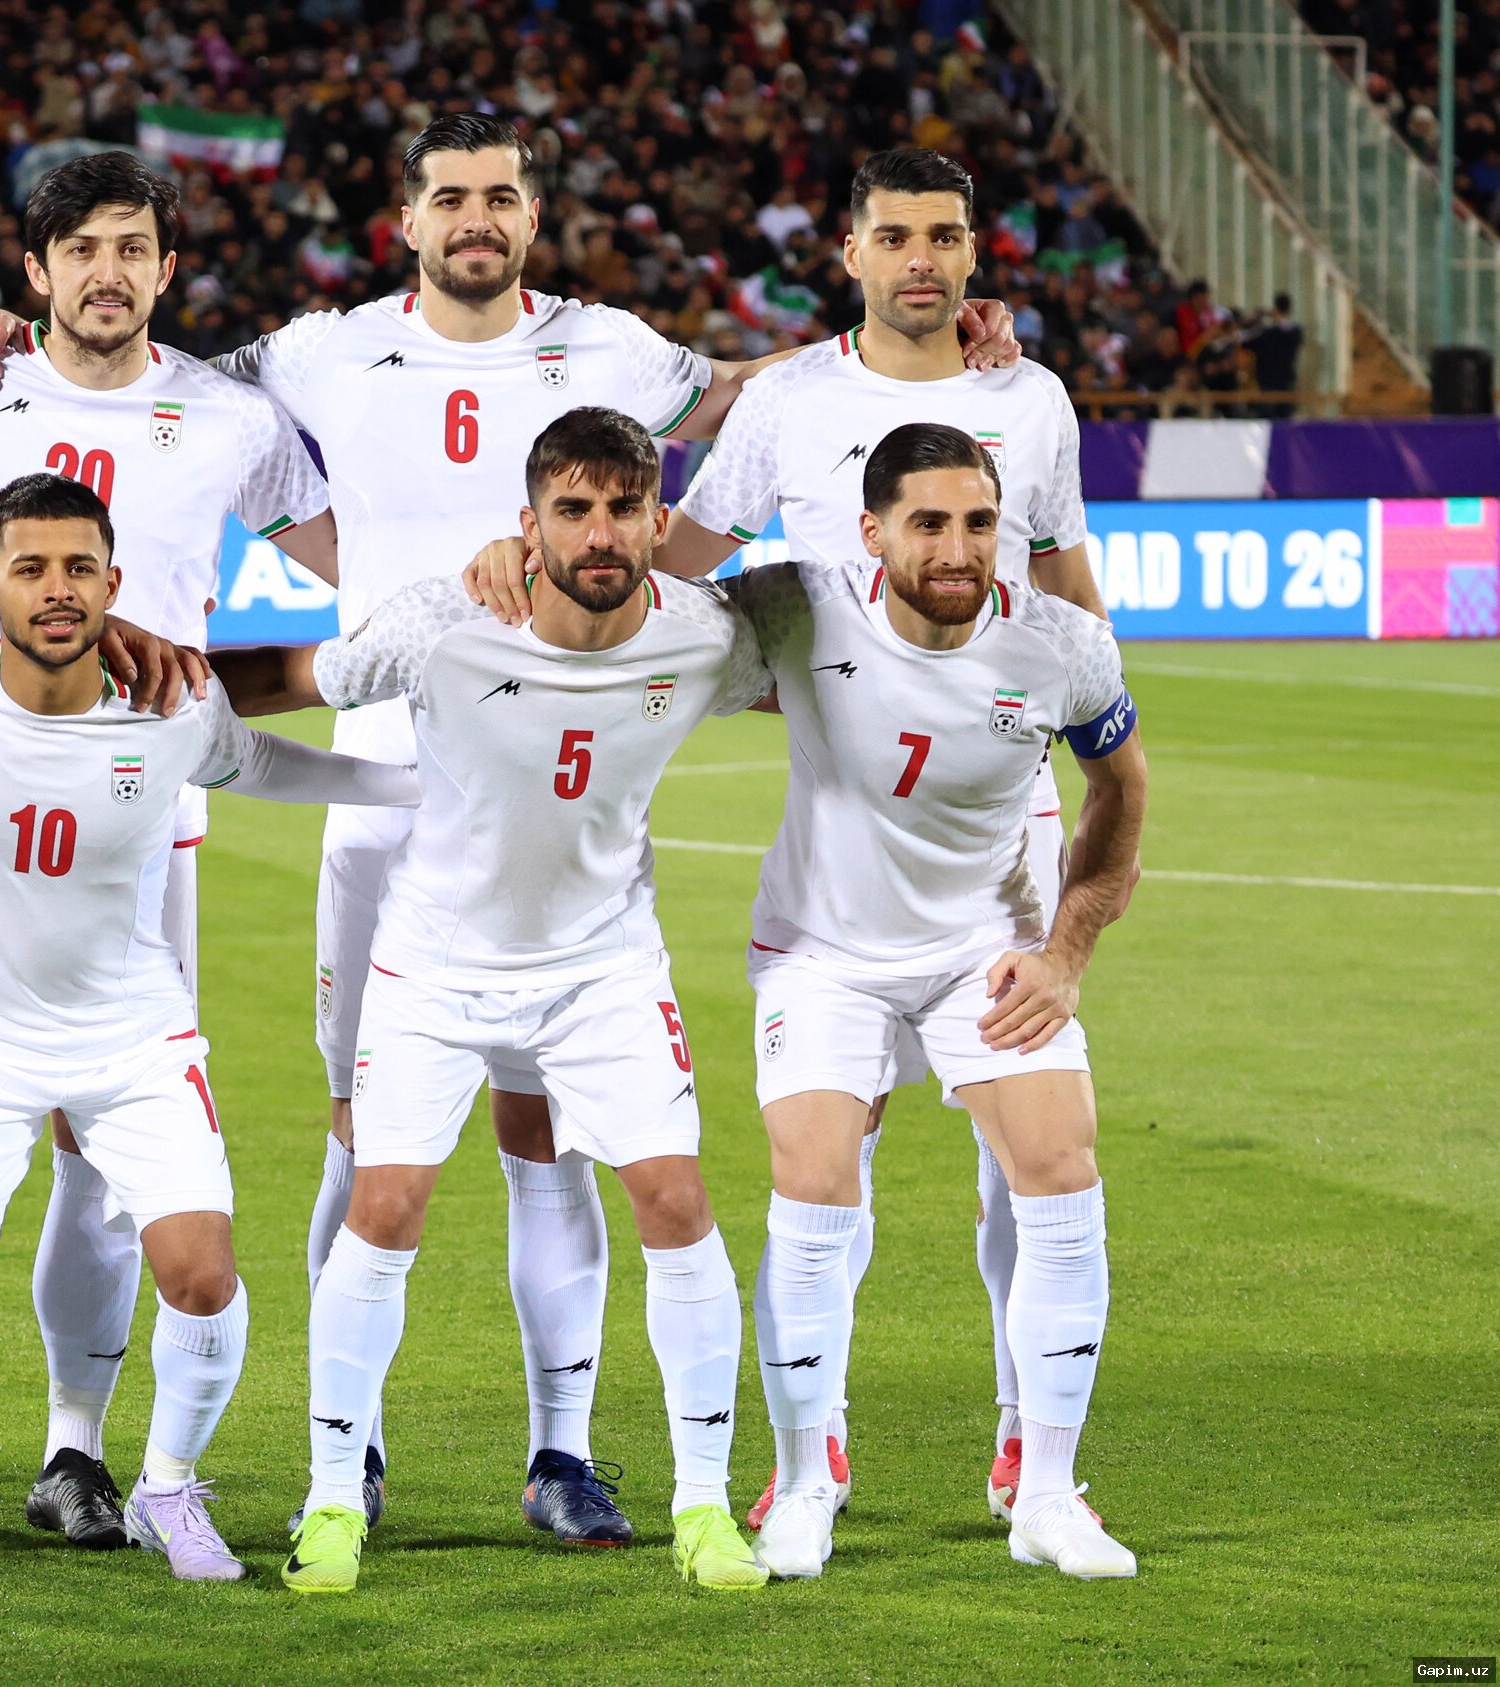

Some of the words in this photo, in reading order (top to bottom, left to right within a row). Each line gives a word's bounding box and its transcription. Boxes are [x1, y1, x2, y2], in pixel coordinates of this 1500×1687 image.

[446, 390, 480, 464] 6
[1194, 530, 1268, 610] TO
[1283, 529, 1364, 609] 26
[554, 729, 594, 800] 5
[893, 732, 932, 798] 7
[10, 804, 77, 877] 10
[657, 1001, 692, 1073] 5
[184, 1064, 219, 1134] 1
